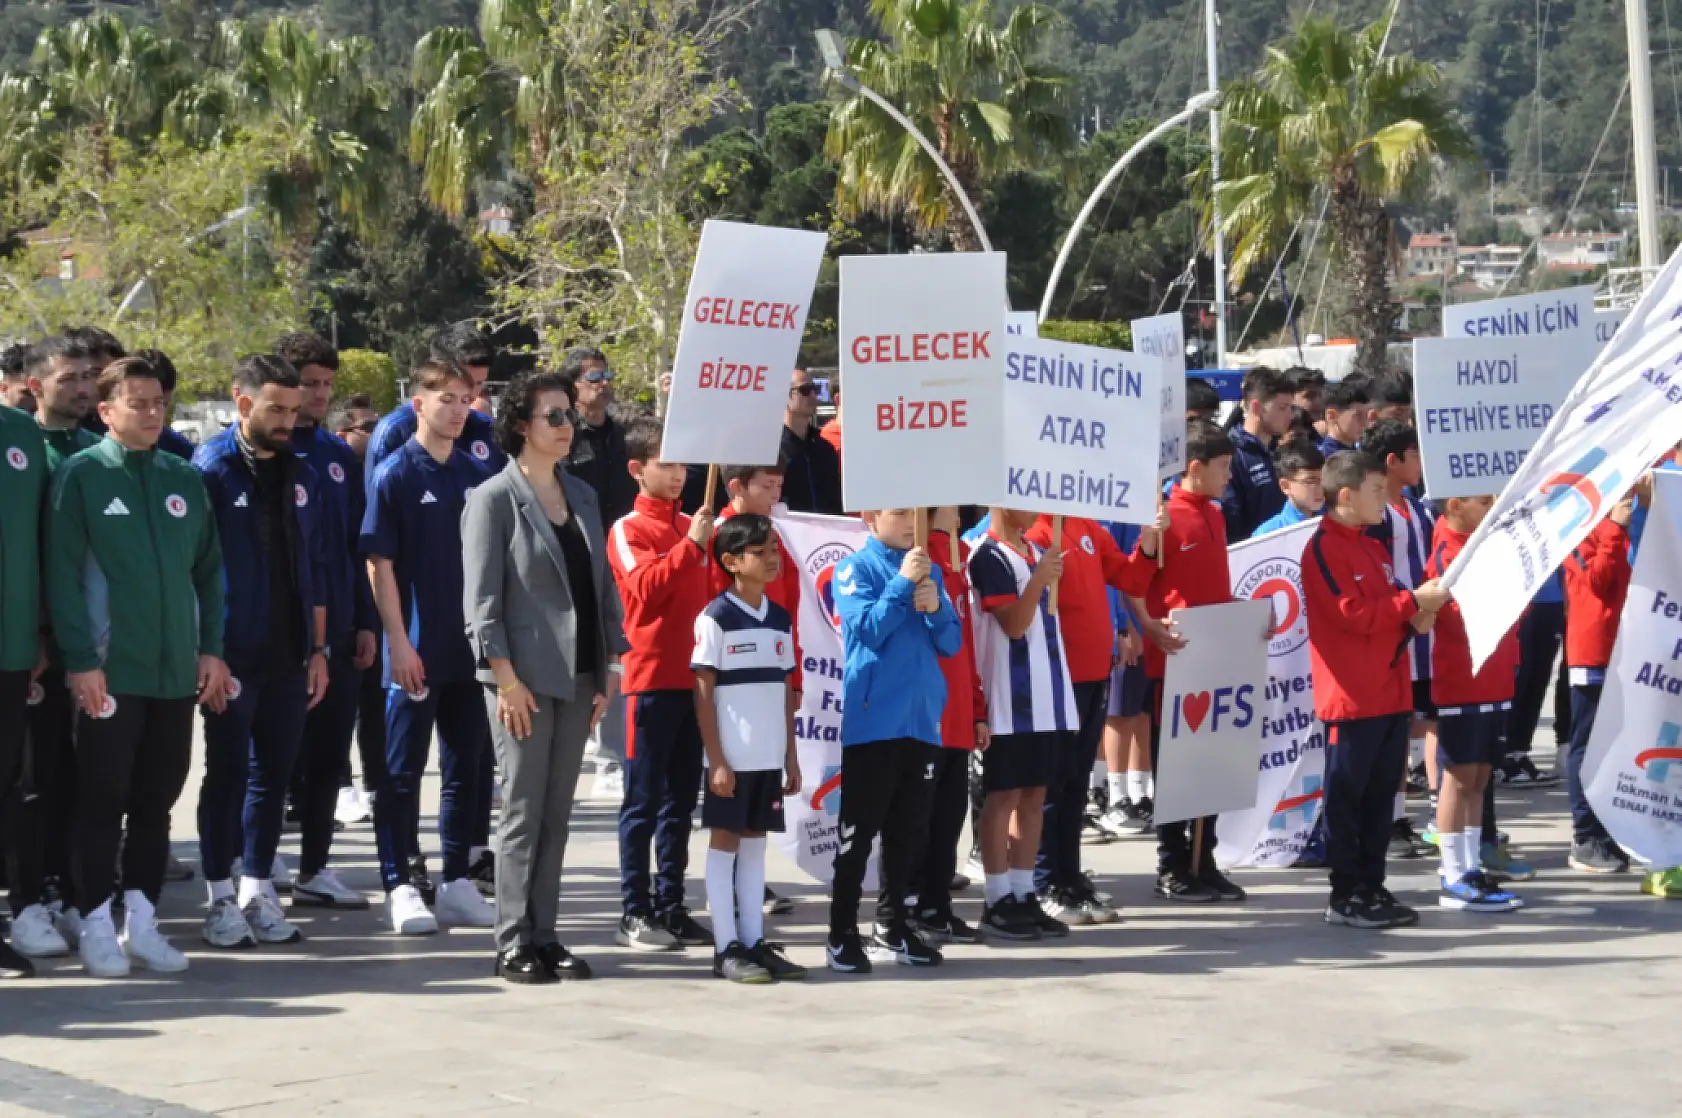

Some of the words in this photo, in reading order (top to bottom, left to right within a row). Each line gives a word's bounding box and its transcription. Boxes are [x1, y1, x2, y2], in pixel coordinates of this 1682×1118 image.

[694, 296, 800, 329] GELECEK
[1464, 307, 1529, 336] SENİN
[1535, 300, 1579, 334] İÇİN
[851, 330, 991, 364] GELECEK
[698, 356, 768, 392] BİZDE
[1006, 352, 1084, 390] SENİN
[1092, 358, 1142, 399] İÇİN
[1456, 353, 1518, 386] HAYDİ
[876, 396, 968, 431] BİZDE
[1425, 400, 1511, 434] FETHİYE
[1039, 414, 1105, 449] ATAR
[1008, 466, 1131, 508] KALBİMİZ
